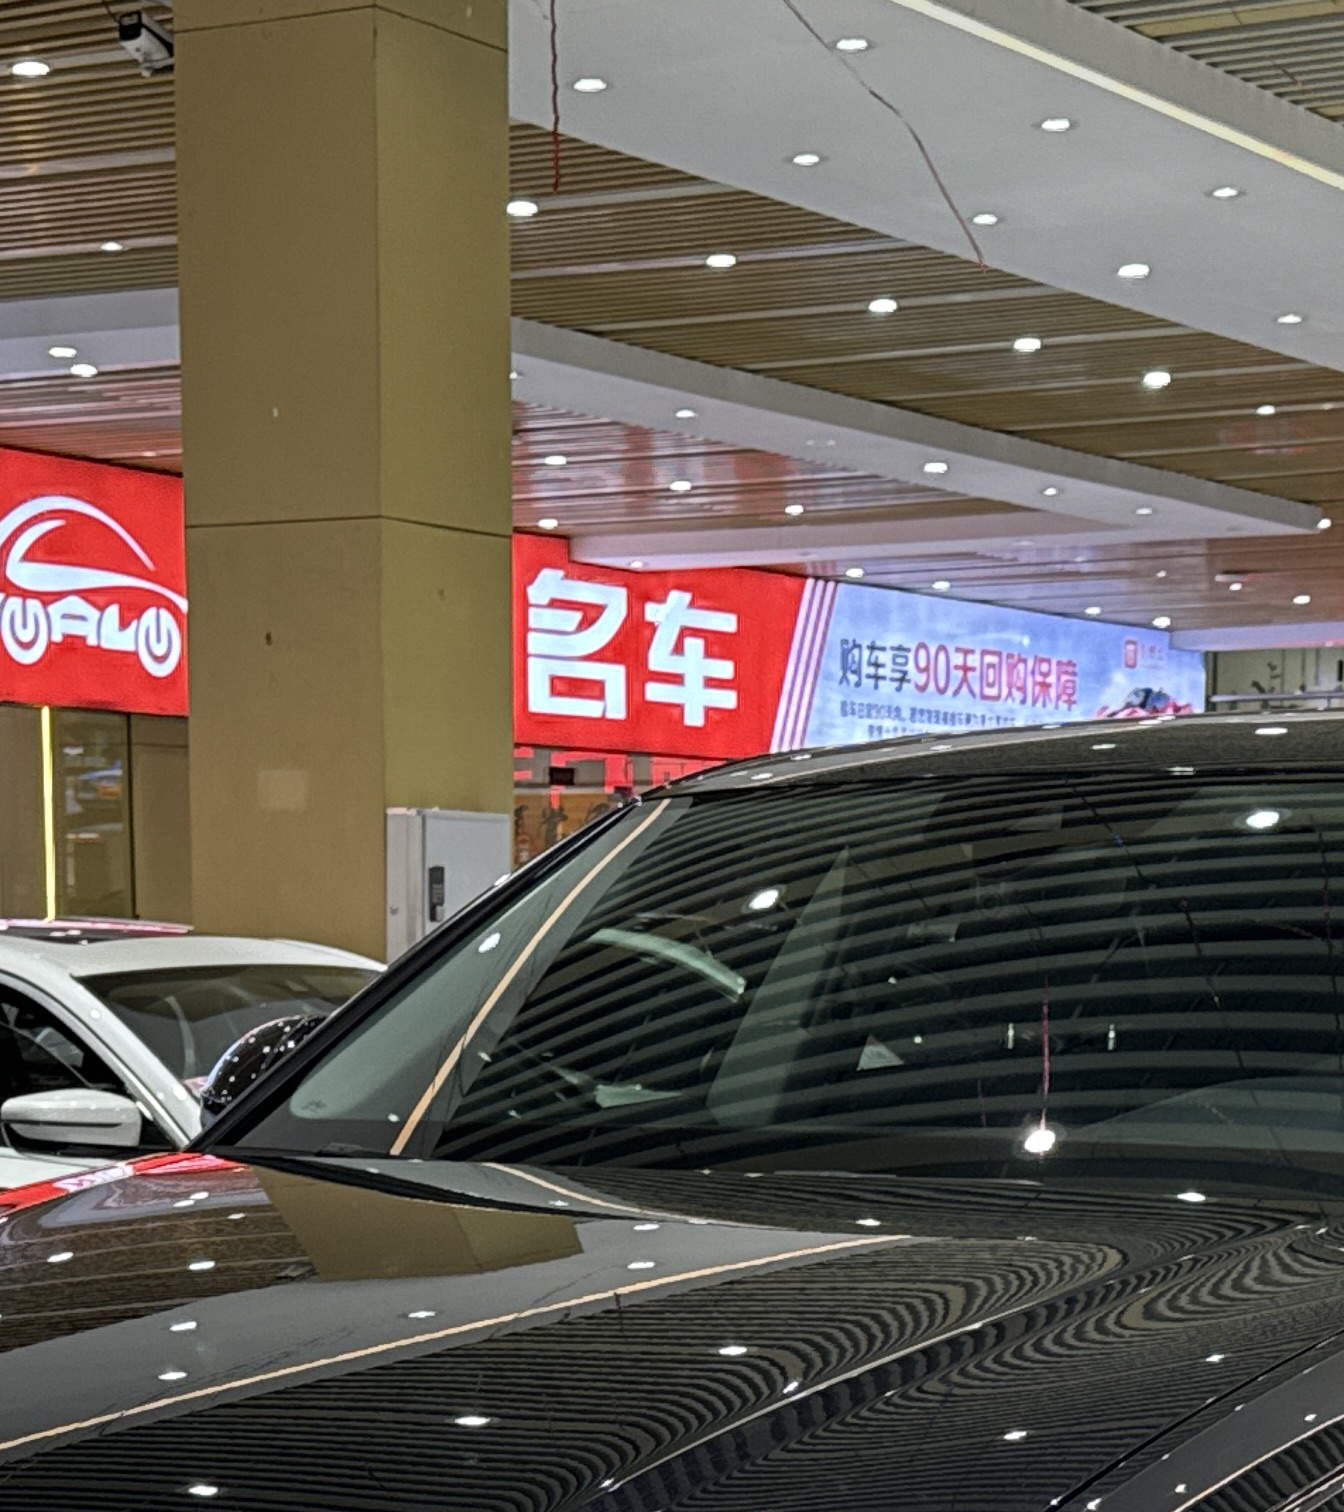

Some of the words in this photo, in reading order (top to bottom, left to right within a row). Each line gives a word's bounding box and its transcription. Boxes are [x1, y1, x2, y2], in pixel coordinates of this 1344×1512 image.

[526, 567, 738, 728] 名车
[839, 638, 1078, 712] 购车享90天回购保障
